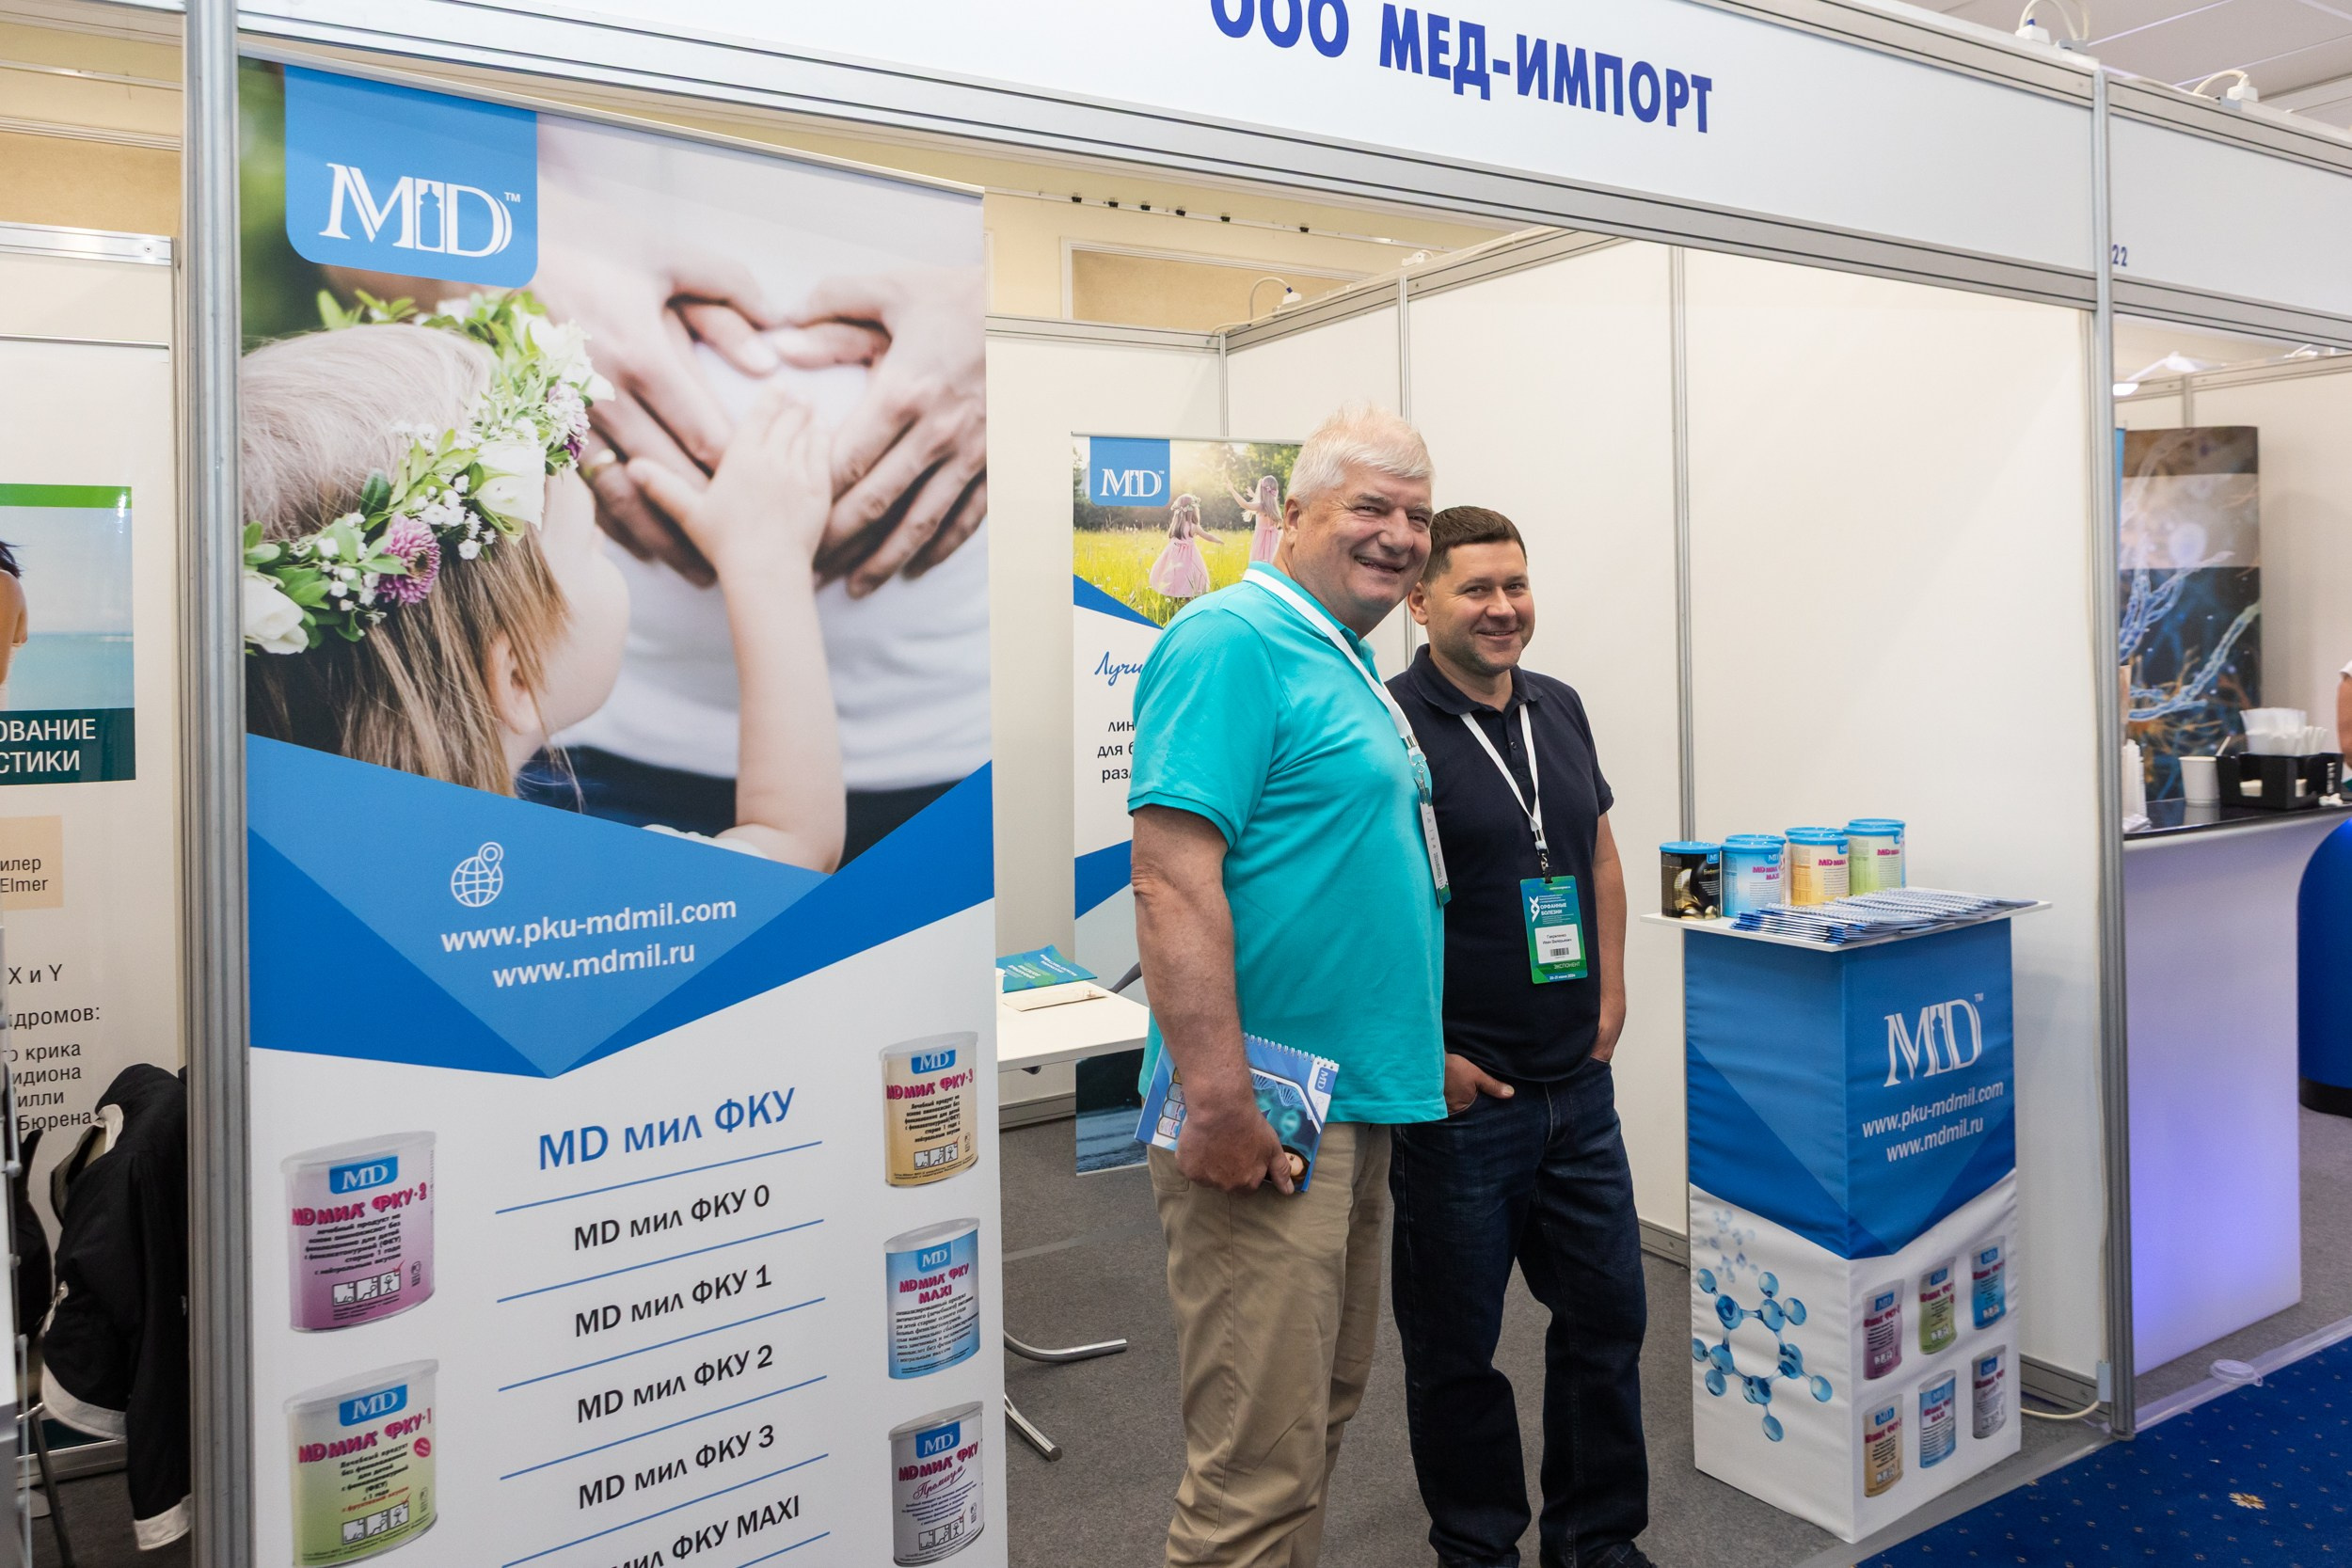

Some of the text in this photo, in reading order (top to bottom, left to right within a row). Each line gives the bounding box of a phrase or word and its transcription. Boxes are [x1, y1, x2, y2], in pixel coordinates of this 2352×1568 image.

[1211, 0, 1712, 134] ООО МЕД-ИМПОРТ
[2112, 245, 2127, 267] 22
[1097, 745, 1122, 758] для
[440, 896, 738, 953] www.pku-mdmil.com
[30, 970, 41, 983] и
[492, 942, 695, 989] www.mdmil.ru
[26, 1043, 82, 1064] крика
[919, 1052, 949, 1070] MD
[539, 1087, 795, 1170] MD мил ФКУ
[1862, 1082, 2004, 1137] www.pku-mdmil.com
[1886, 1117, 1983, 1162] www.mdmil.ru
[342, 1164, 389, 1190] MD
[574, 1184, 770, 1250] MD мил ФКУ 0
[922, 1250, 947, 1267] MD
[575, 1265, 771, 1337] MD мил ФКУ 1
[918, 1284, 952, 1305] MAXI
[353, 1392, 397, 1419] MD
[578, 1345, 773, 1423] MD мил ФКУ 2
[924, 1433, 953, 1455] MD
[579, 1425, 774, 1509] MD мил ФКУ 3
[672, 1520, 729, 1560] ФКУ
[737, 1496, 799, 1538] MAXI
